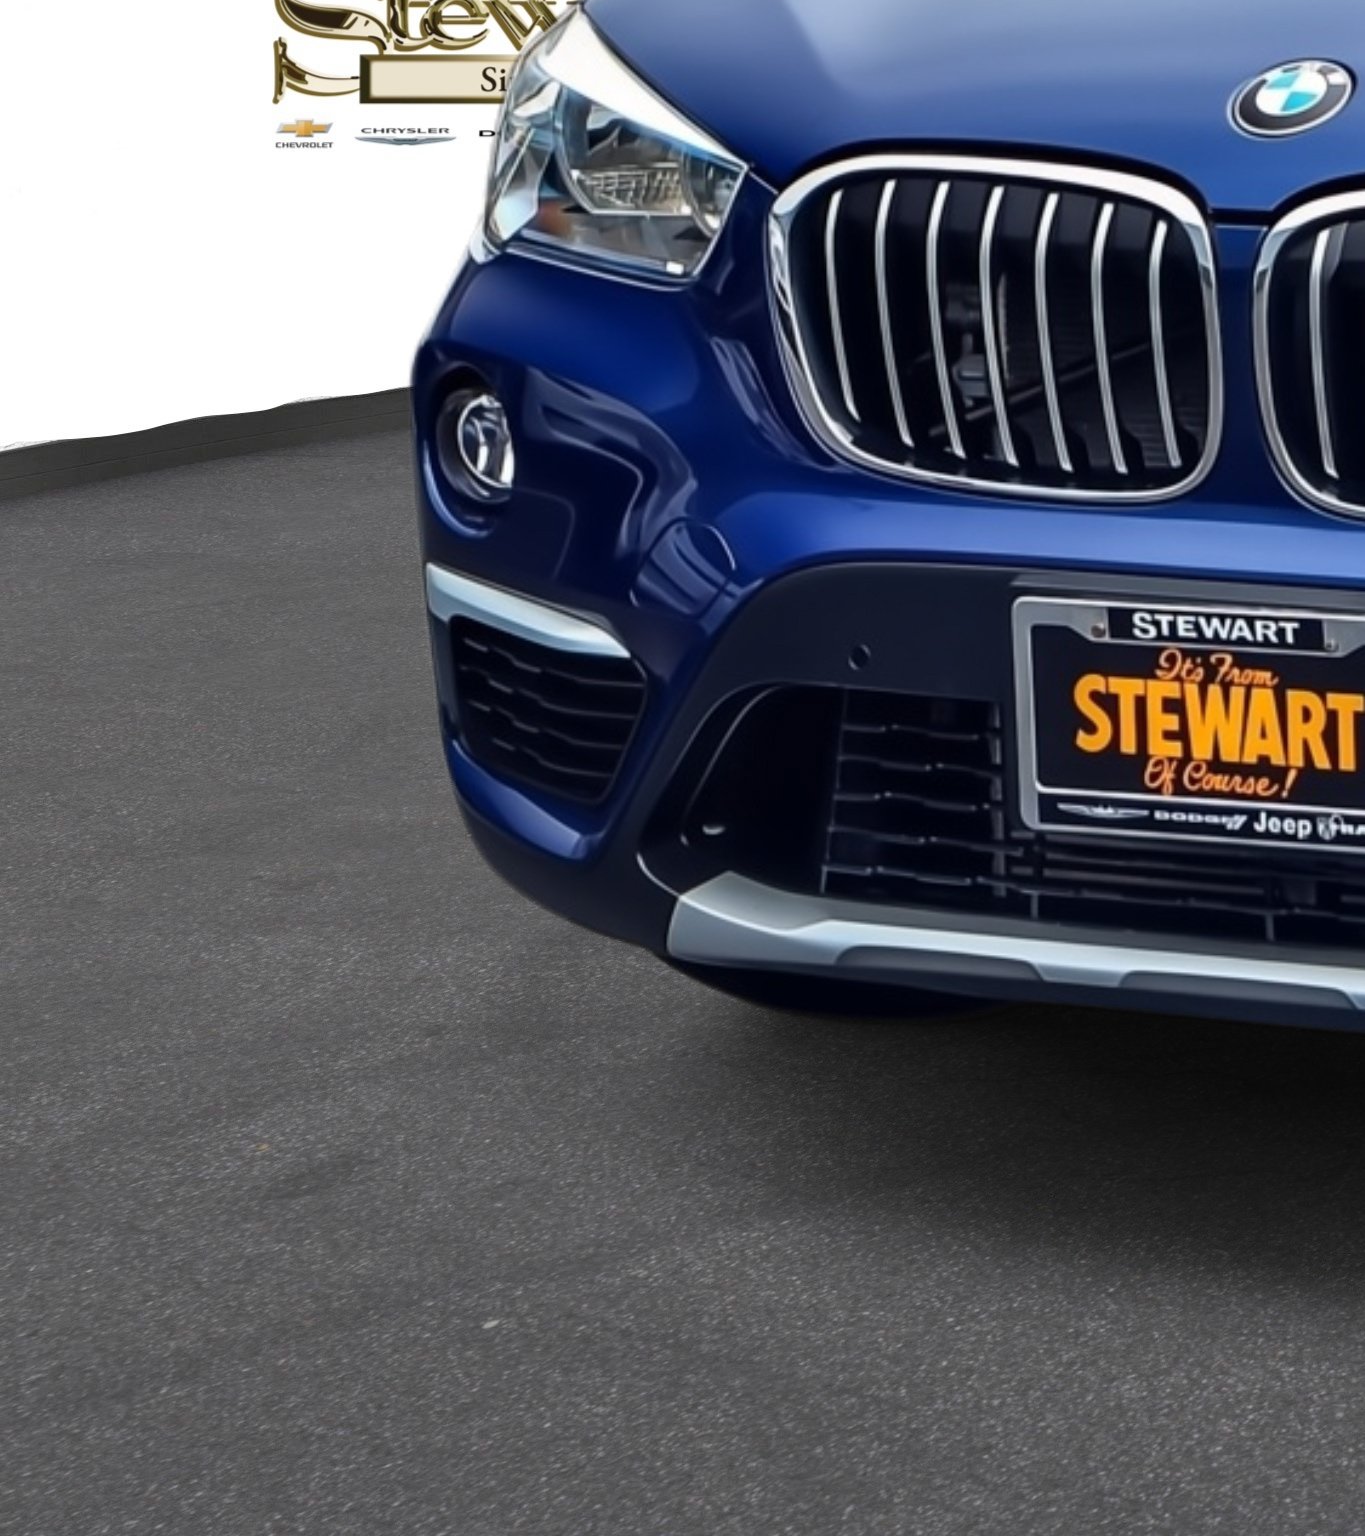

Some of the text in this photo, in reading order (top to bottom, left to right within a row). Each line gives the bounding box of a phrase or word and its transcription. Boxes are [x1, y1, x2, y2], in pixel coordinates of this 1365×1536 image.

[1132, 611, 1300, 645] STEWART
[1155, 648, 1279, 687] It's From
[1073, 673, 1365, 772] STEWART
[1144, 756, 1177, 796] Of
[1253, 811, 1312, 838] Jeep
